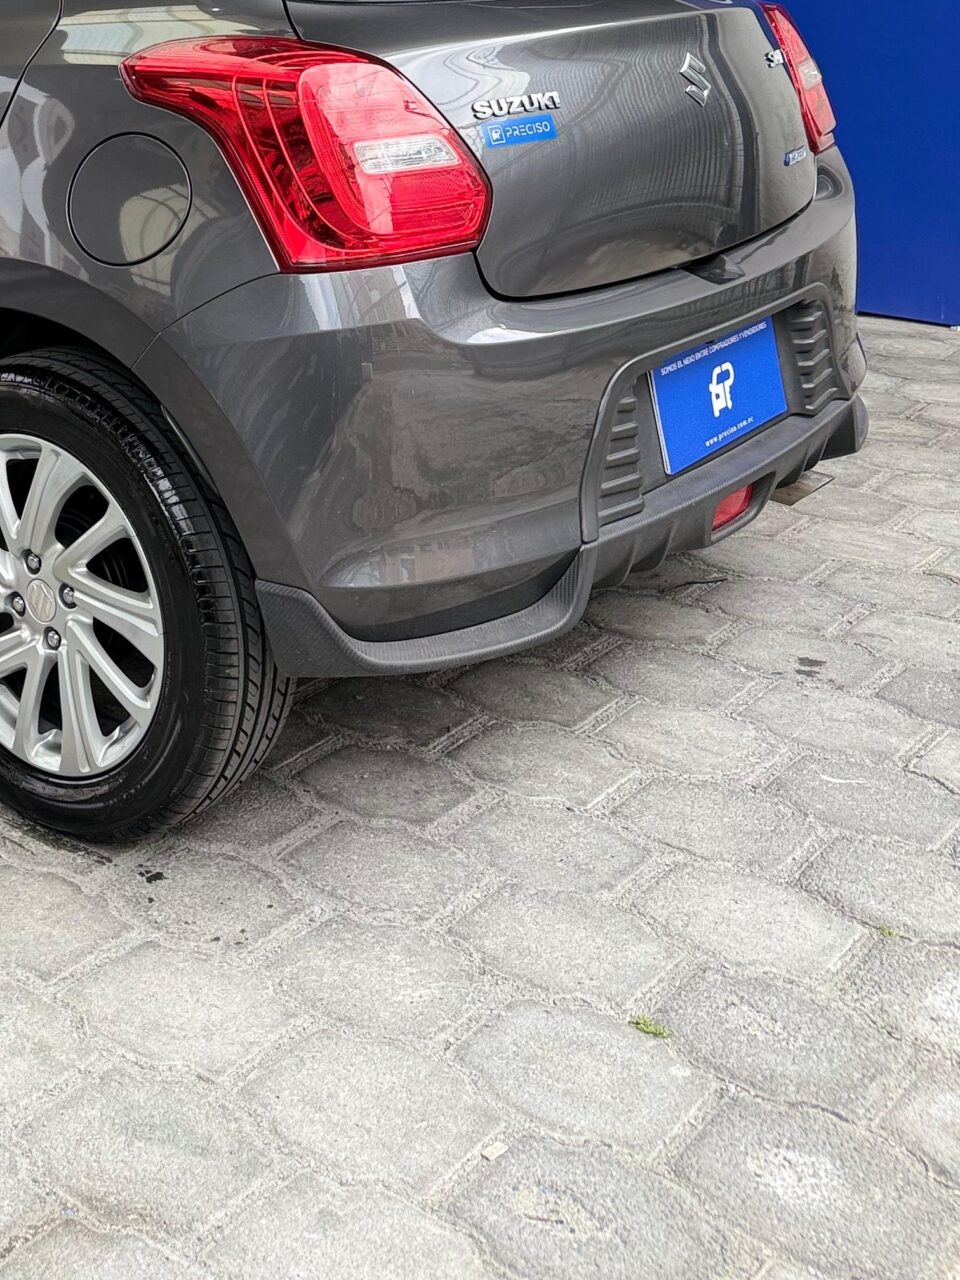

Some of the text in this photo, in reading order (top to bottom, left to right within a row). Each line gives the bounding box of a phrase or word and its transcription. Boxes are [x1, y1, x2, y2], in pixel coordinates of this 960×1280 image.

[471, 91, 561, 120] SUZUKI
[505, 121, 551, 138] PRECISO
[660, 362, 678, 376] SOMOS
[677, 360, 684, 369] EL
[695, 348, 709, 360] ENTRE
